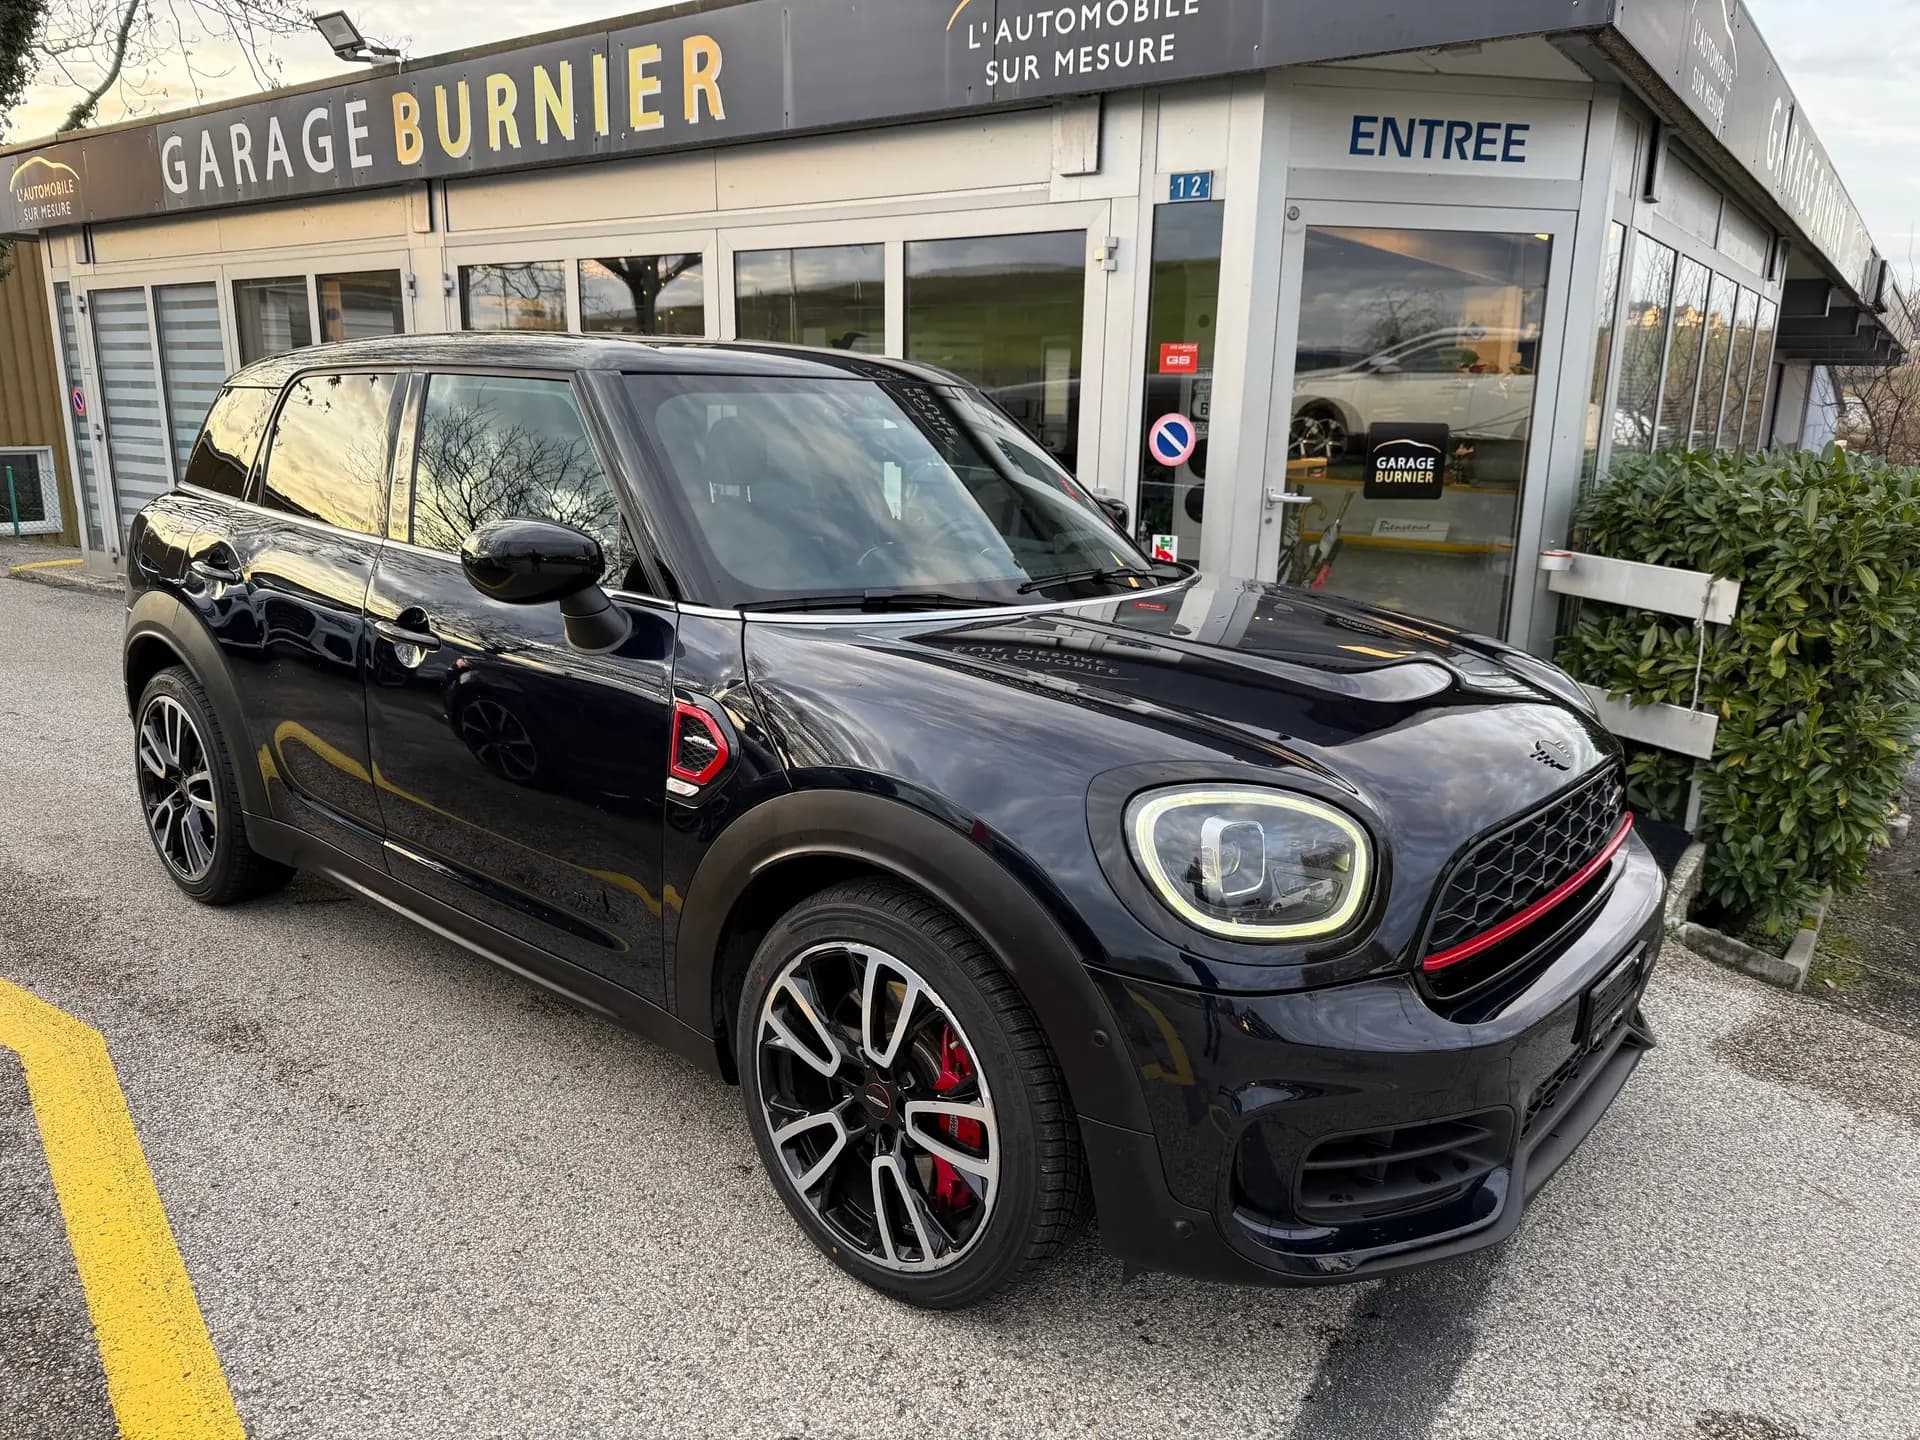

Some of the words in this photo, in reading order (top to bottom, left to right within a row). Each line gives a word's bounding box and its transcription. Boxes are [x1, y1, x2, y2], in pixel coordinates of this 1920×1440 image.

[967, 0, 1200, 49] L'AUTOMOBILE
[985, 54, 1041, 86] SUR
[1054, 33, 1176, 77] MESURE
[162, 99, 374, 195] GARAGE
[392, 34, 726, 167] BURNIER
[1349, 115, 1531, 163] ENTREE
[1766, 96, 1819, 217] GARAGE
[16, 179, 75, 203] L'AUTOMOBILE
[1177, 175, 1202, 198] 12
[23, 206, 40, 222] SUR
[41, 201, 72, 220] MESURE
[1375, 470, 1434, 484] BURNIER
[1376, 456, 1436, 470] GARAGE
